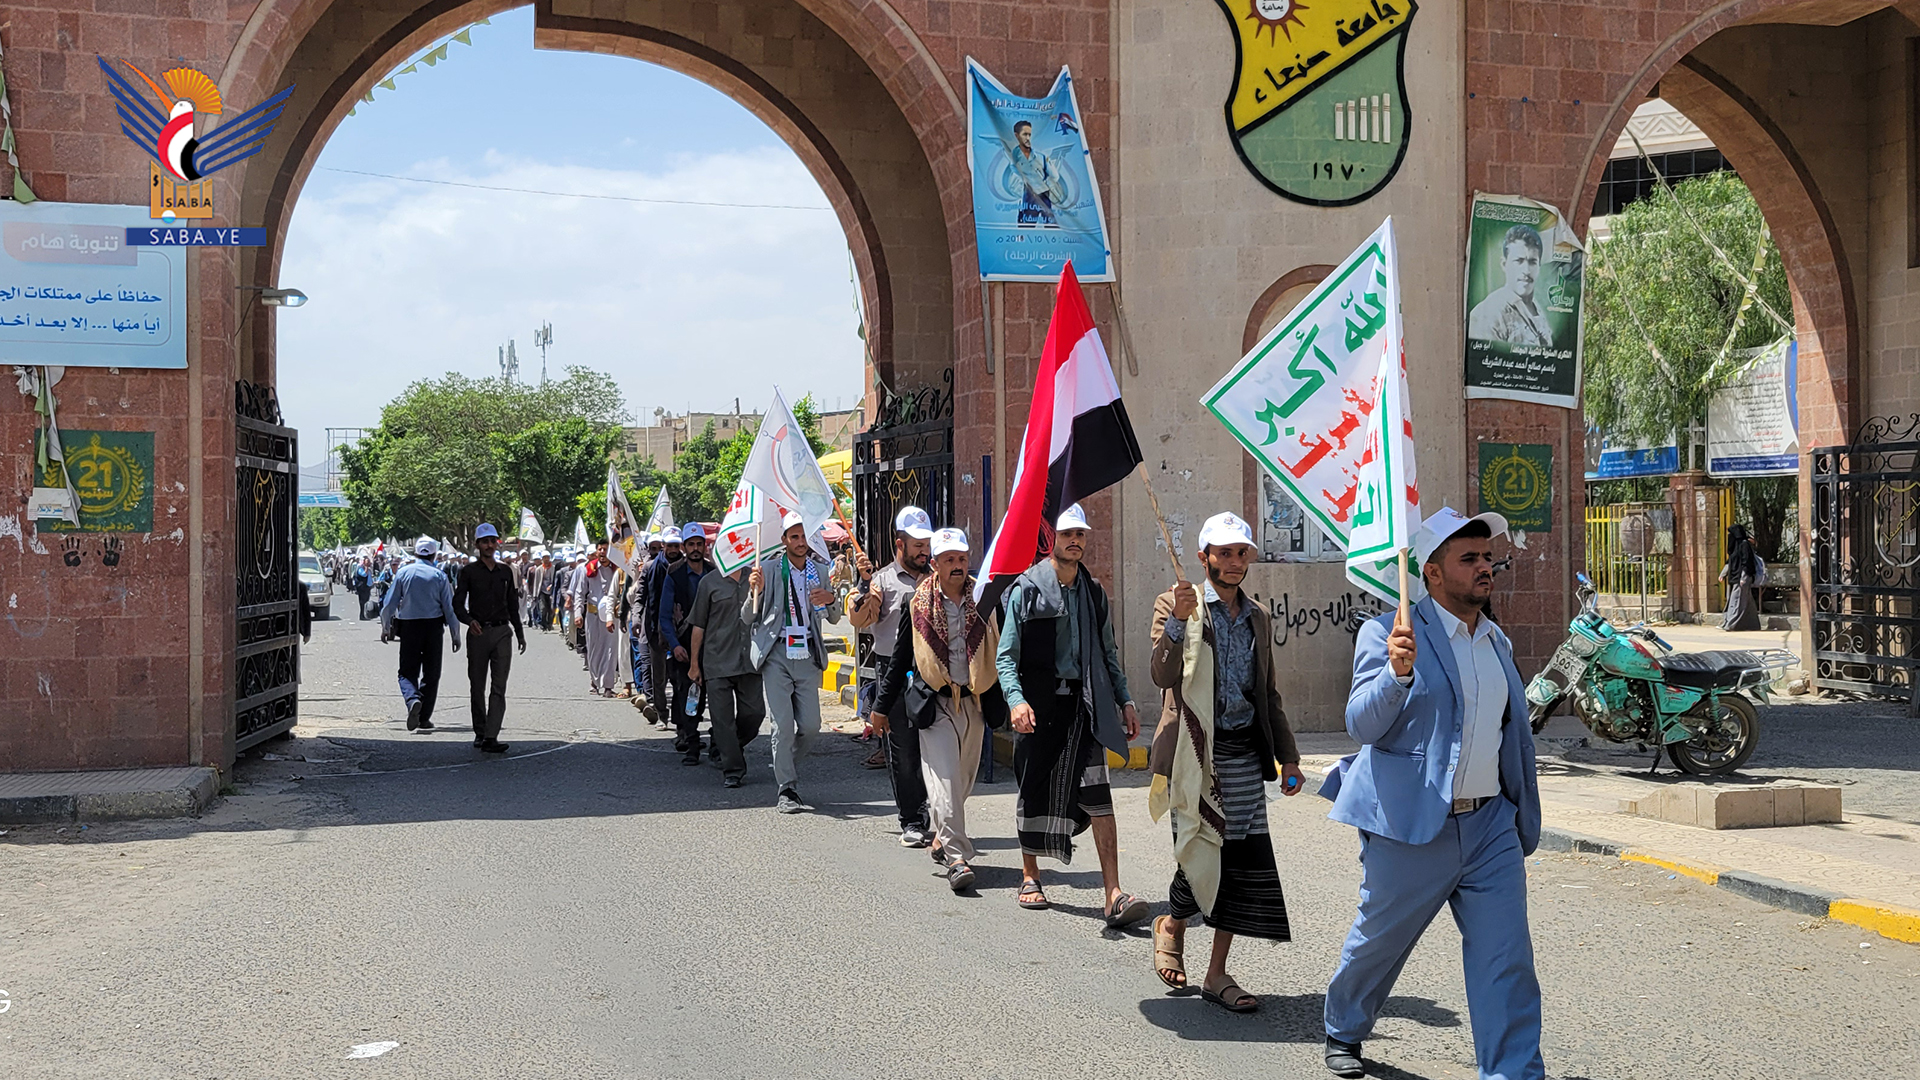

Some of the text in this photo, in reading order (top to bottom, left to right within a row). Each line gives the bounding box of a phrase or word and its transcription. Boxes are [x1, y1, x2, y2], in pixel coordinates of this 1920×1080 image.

[1254, 0, 1400, 104] جامعة صنعاء
[1313, 162, 1366, 180] ١٩٧٠
[21, 233, 65, 252] هام
[24, 286, 82, 301] ممتلكات
[85, 288, 114, 304] على
[35, 318, 67, 332] بعد
[70, 316, 88, 332] إلا
[112, 318, 140, 333] منها
[1254, 323, 1338, 447] أكبر
[78, 460, 112, 488] 21
[1504, 467, 1526, 490] 21
[84, 522, 102, 532] وجه
[102, 522, 116, 532] في
[117, 522, 135, 532] ثورة
